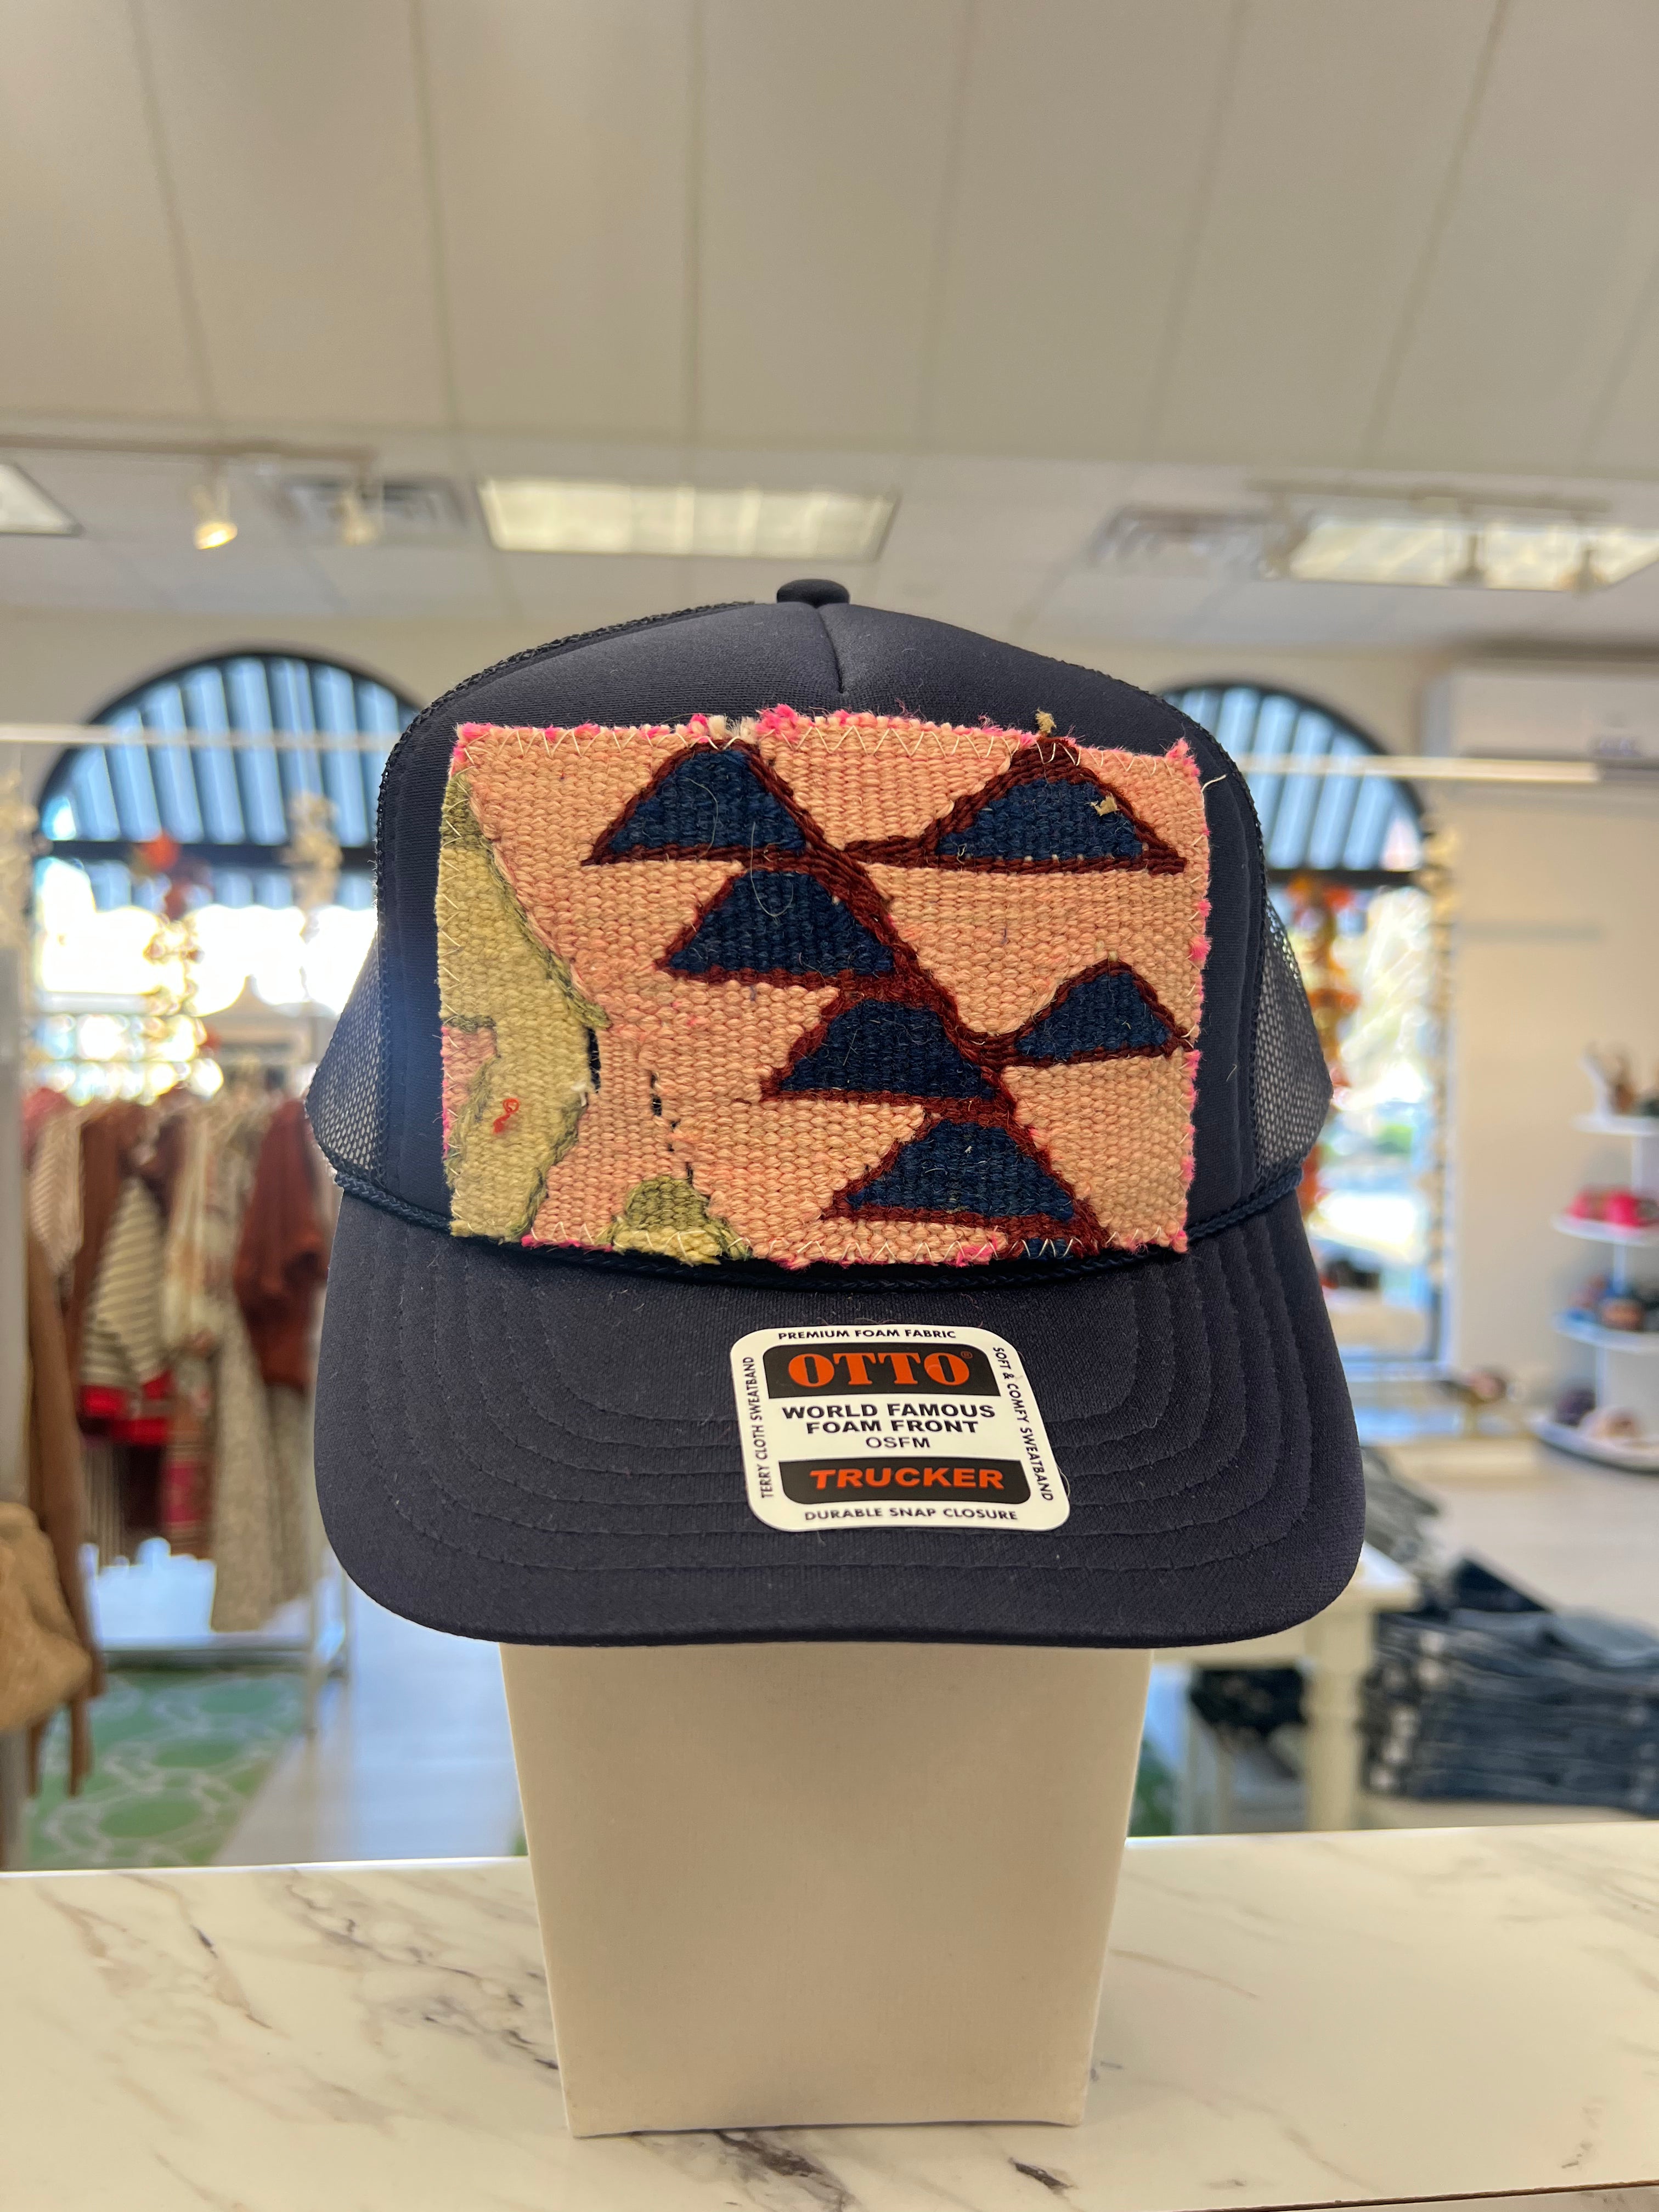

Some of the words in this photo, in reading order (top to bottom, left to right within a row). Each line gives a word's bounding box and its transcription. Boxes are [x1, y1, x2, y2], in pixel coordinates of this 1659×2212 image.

[778, 1330, 849, 1340] PREMIUM
[855, 1329, 899, 1338] FOAM
[905, 1329, 956, 1339] FABRIC
[993, 1346, 1012, 1370] SOFT
[1002, 1371, 1014, 1382] &
[743, 1357, 763, 1421] SWEATBAND
[782, 1404, 877, 1419] WORLD
[888, 1403, 995, 1418] FAMOUS
[1006, 1383, 1030, 1423] COMFY
[806, 1420, 882, 1434] FOAM
[892, 1420, 978, 1434] FRONT
[752, 1425, 769, 1460] CLOTH
[866, 1436, 930, 1449] OSFM
[1020, 1427, 1053, 1500] SWEATBAND
[757, 1464, 774, 1498] TERRY
[809, 1468, 1005, 1489] TRUCKER
[805, 1507, 883, 1521] DURABLE
[890, 1508, 936, 1517] SNAP
[944, 1509, 1018, 1520] CLOSURE
